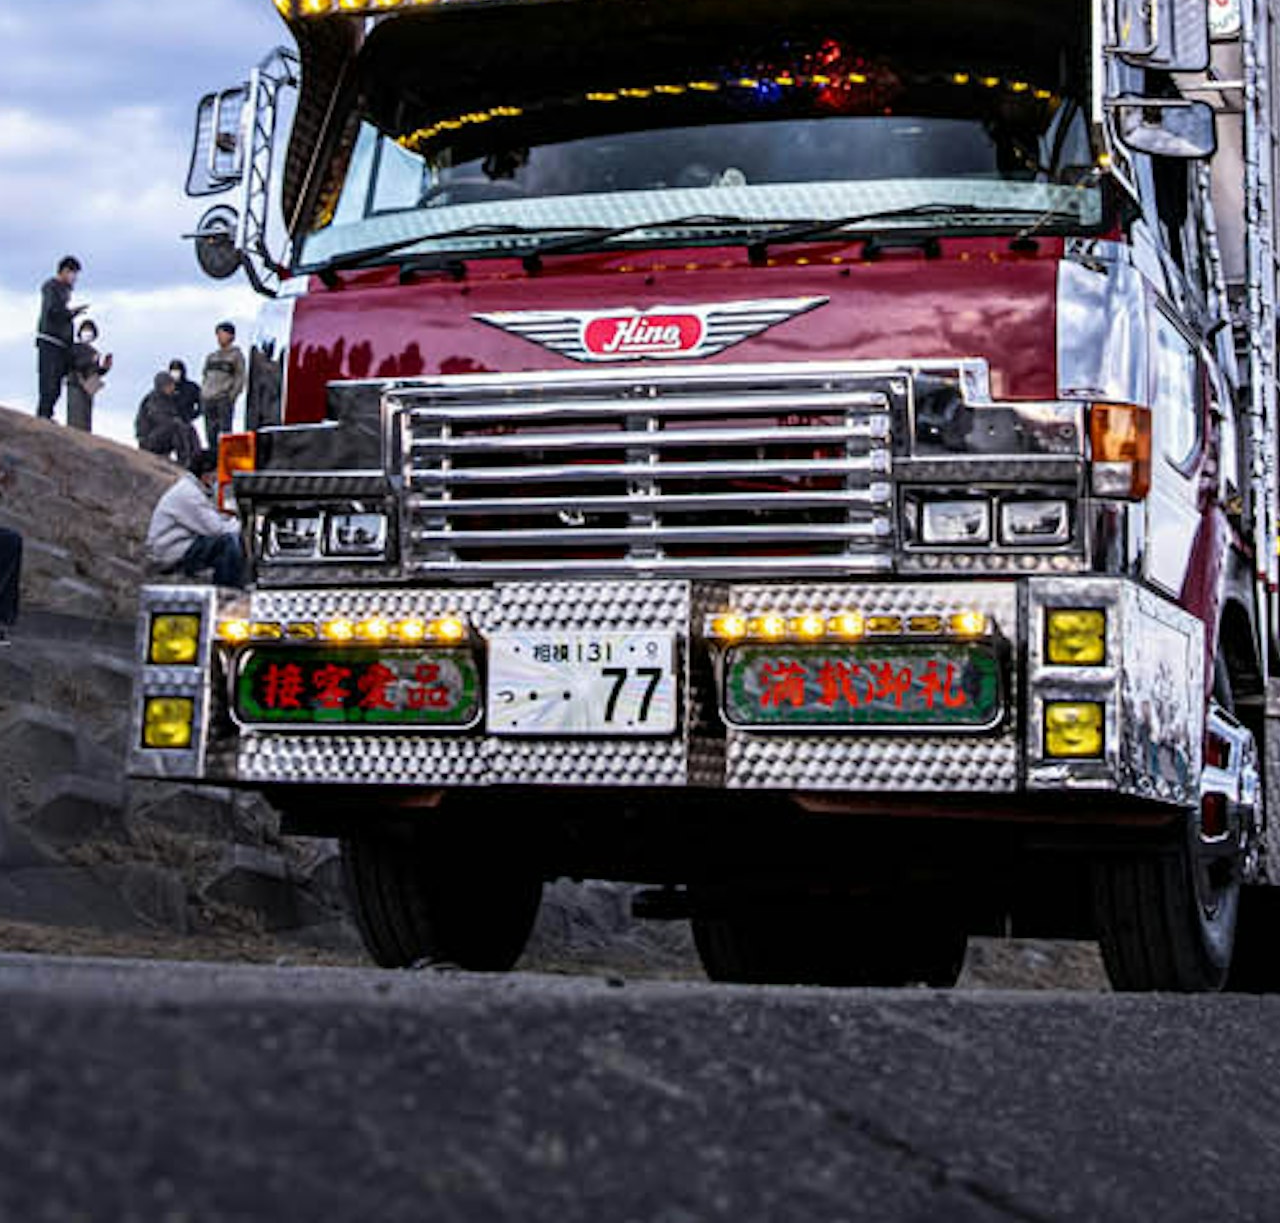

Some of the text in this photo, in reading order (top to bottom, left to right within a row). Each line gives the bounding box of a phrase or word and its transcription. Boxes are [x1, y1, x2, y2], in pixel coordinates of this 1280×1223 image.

[603, 315, 681, 352] Hino
[759, 660, 966, 709] 満載御礼
